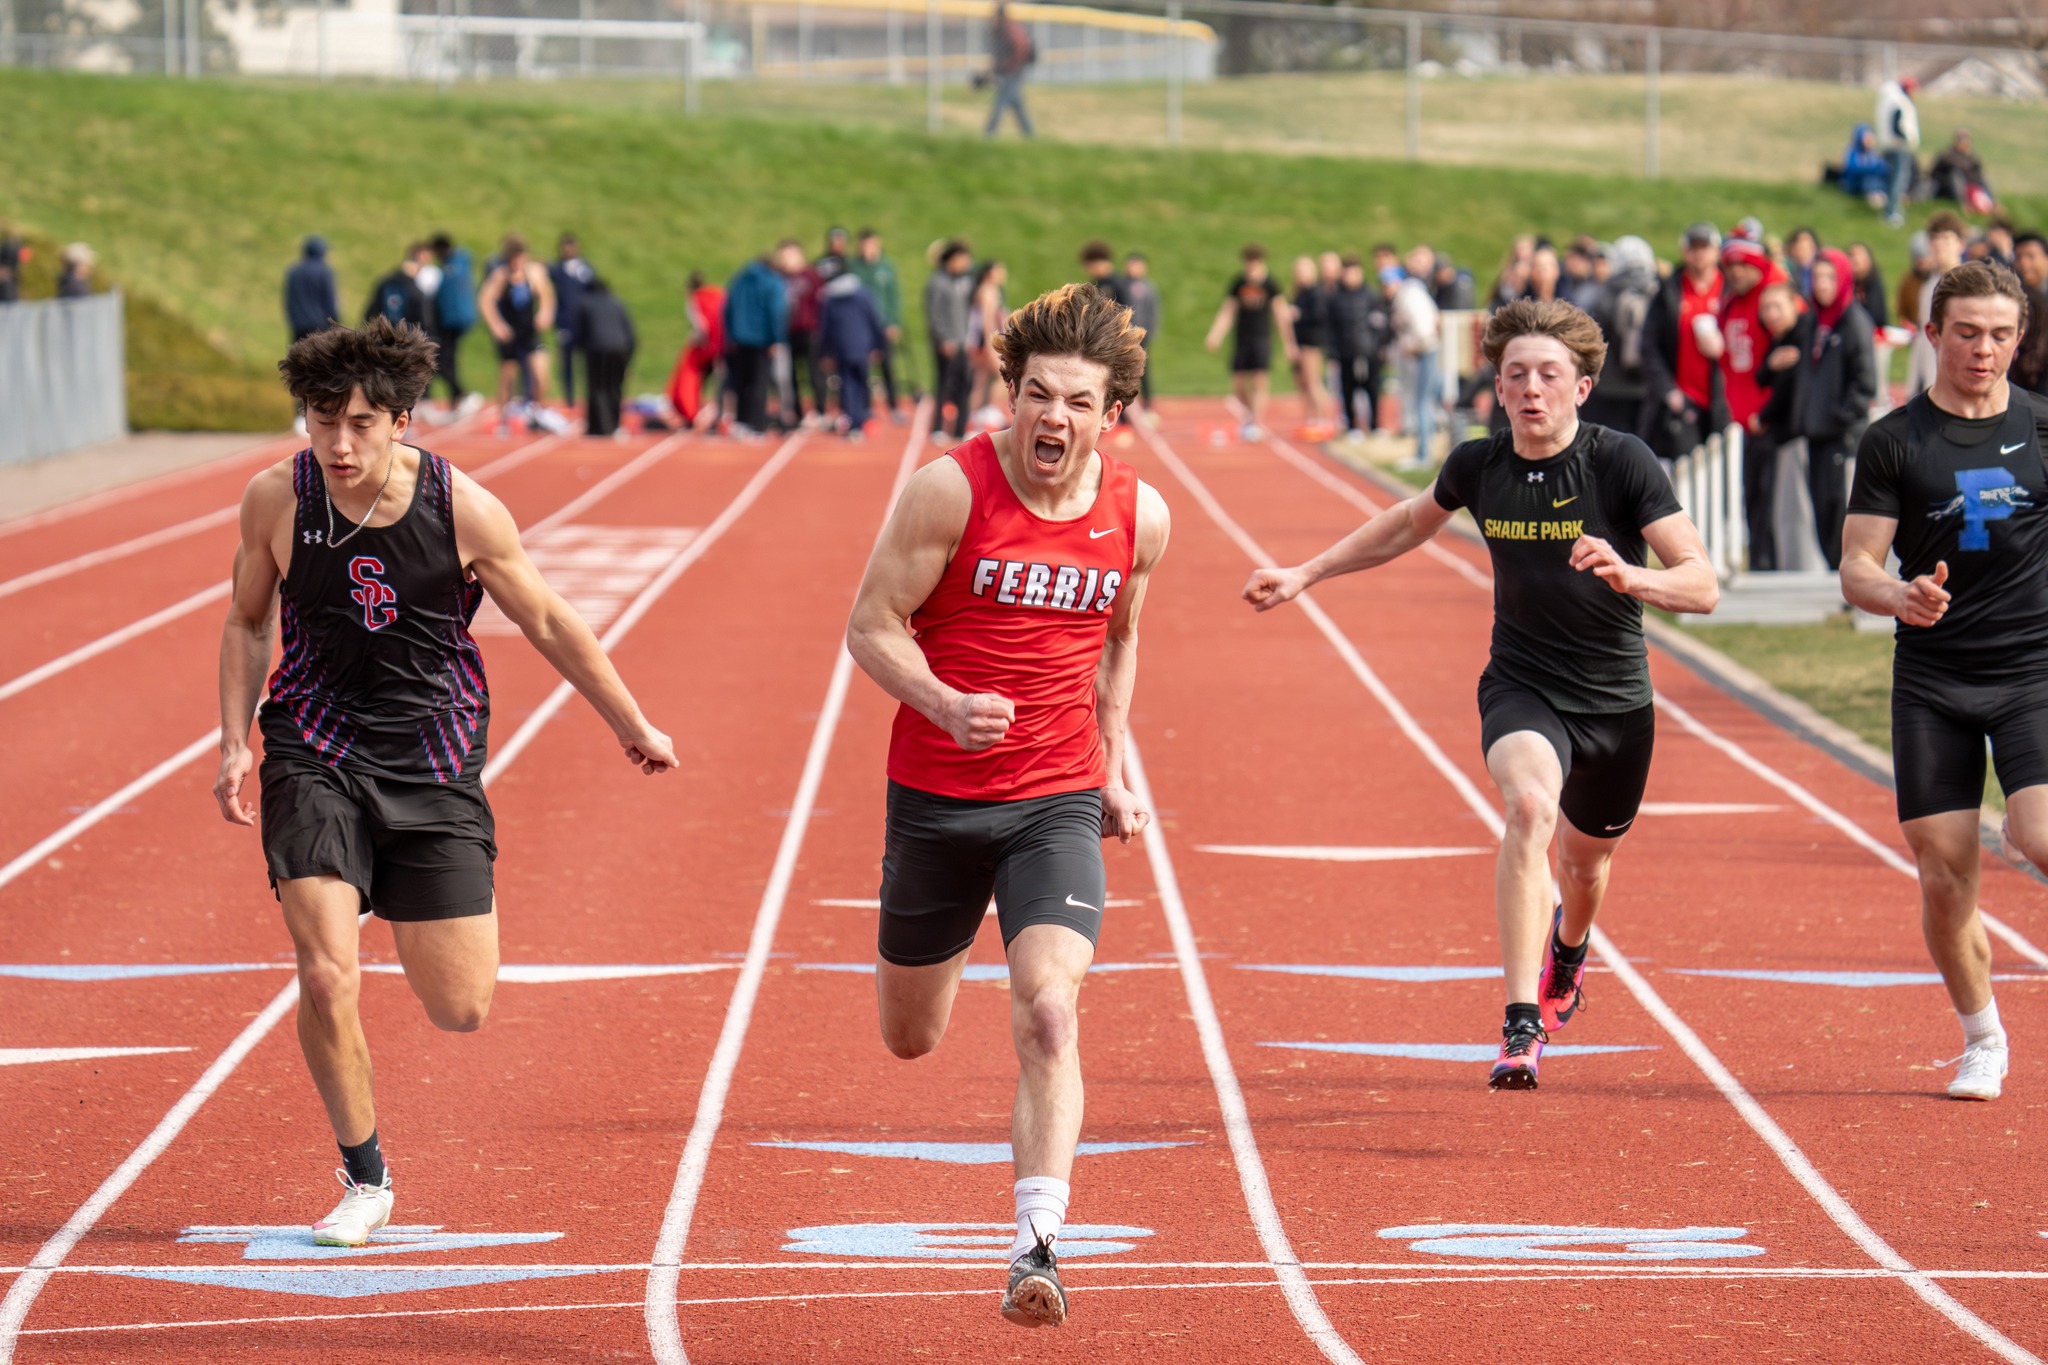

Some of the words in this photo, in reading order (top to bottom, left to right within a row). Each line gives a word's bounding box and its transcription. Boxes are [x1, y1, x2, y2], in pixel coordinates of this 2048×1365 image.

[1484, 519, 1537, 540] SHADLE
[1541, 520, 1584, 540] PARK
[1954, 467, 2016, 551] P
[971, 557, 1122, 612] FERRIS
